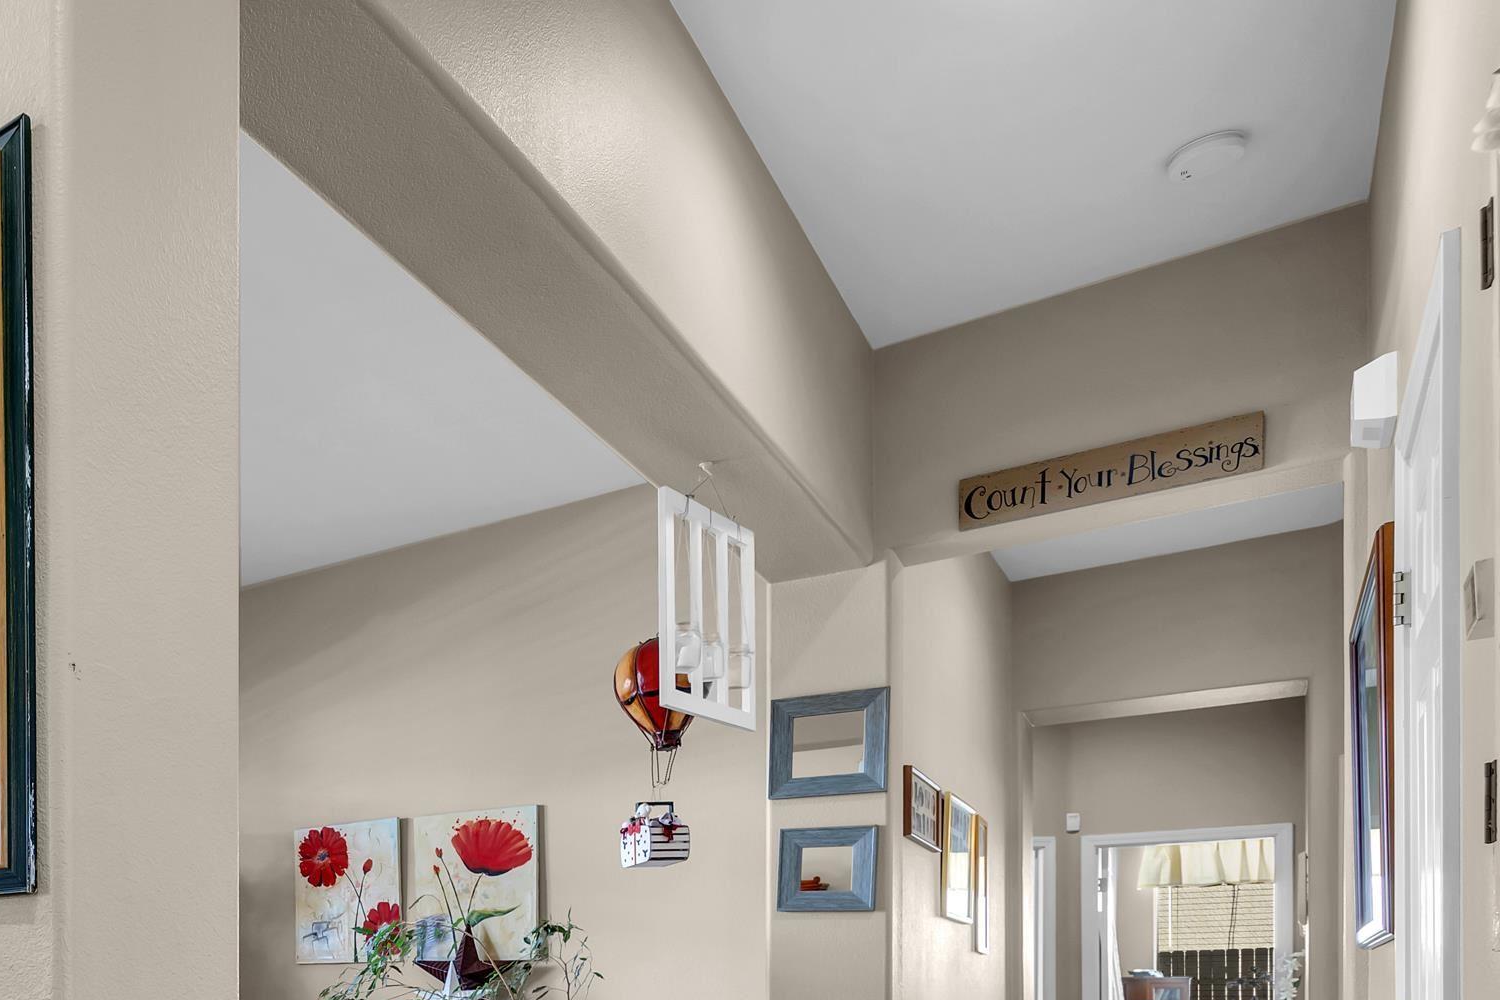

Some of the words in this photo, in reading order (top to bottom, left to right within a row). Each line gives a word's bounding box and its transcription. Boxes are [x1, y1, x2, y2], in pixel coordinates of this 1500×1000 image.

[964, 468, 1051, 520] Count
[1059, 467, 1117, 499] Your
[1127, 436, 1260, 485] Blessings
